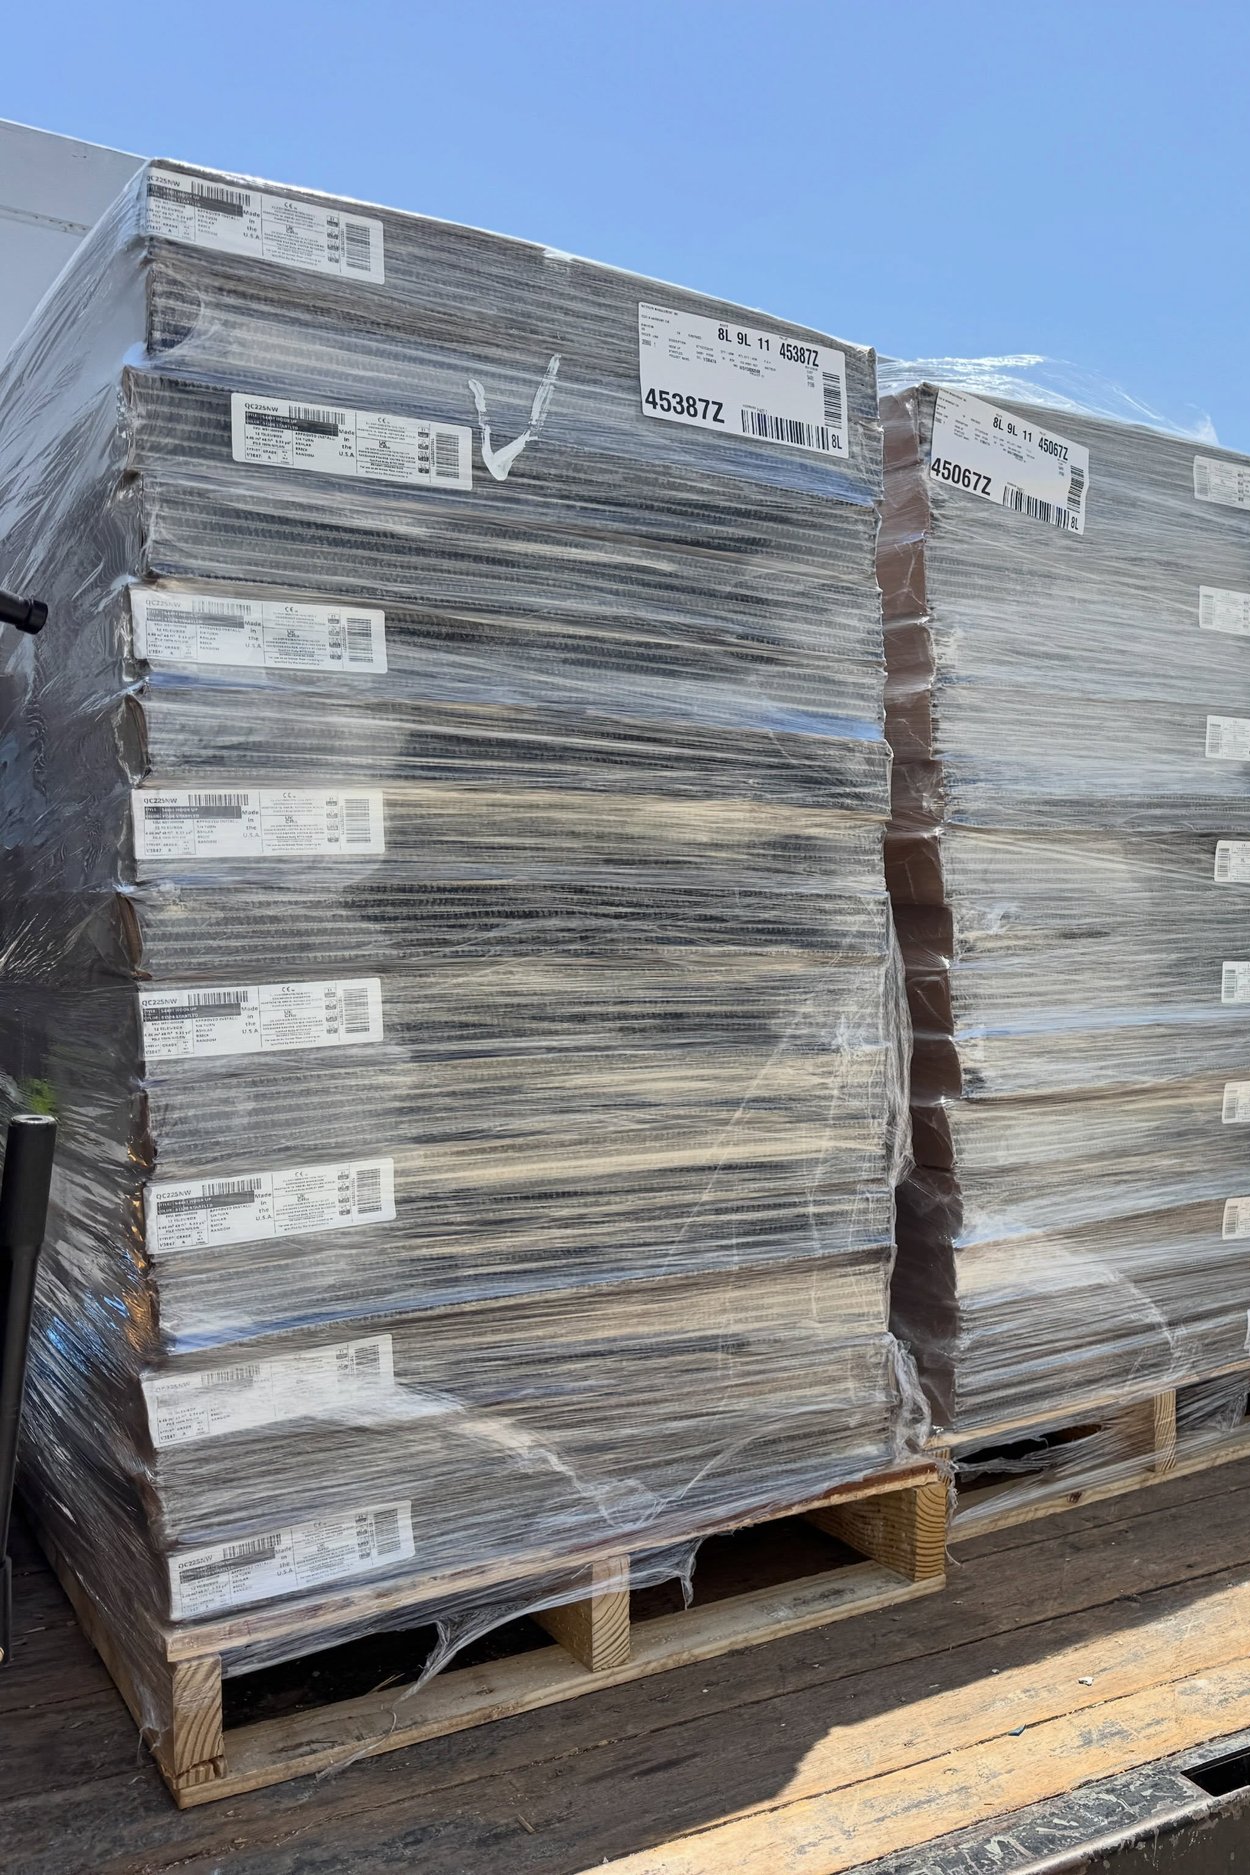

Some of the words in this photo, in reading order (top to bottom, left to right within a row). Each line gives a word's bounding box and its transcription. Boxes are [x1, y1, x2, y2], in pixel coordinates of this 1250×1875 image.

[718, 328, 732, 342] 8L
[737, 332, 751, 347] 9L
[758, 337, 770, 351] 11
[779, 342, 819, 367] 45387Z
[244, 402, 278, 412] QC225NW
[645, 388, 725, 424] 45387Z
[831, 434, 842, 450] 8L
[992, 416, 1004, 431] 8L
[1007, 422, 1018, 436] 9L
[1022, 430, 1032, 443] 11
[1038, 437, 1068, 461] 45067Z
[931, 457, 992, 496] 45067Z
[1070, 516, 1078, 531] 8L
[142, 998, 178, 1006] QC225NW
[156, 1190, 192, 1200] QC225NW
